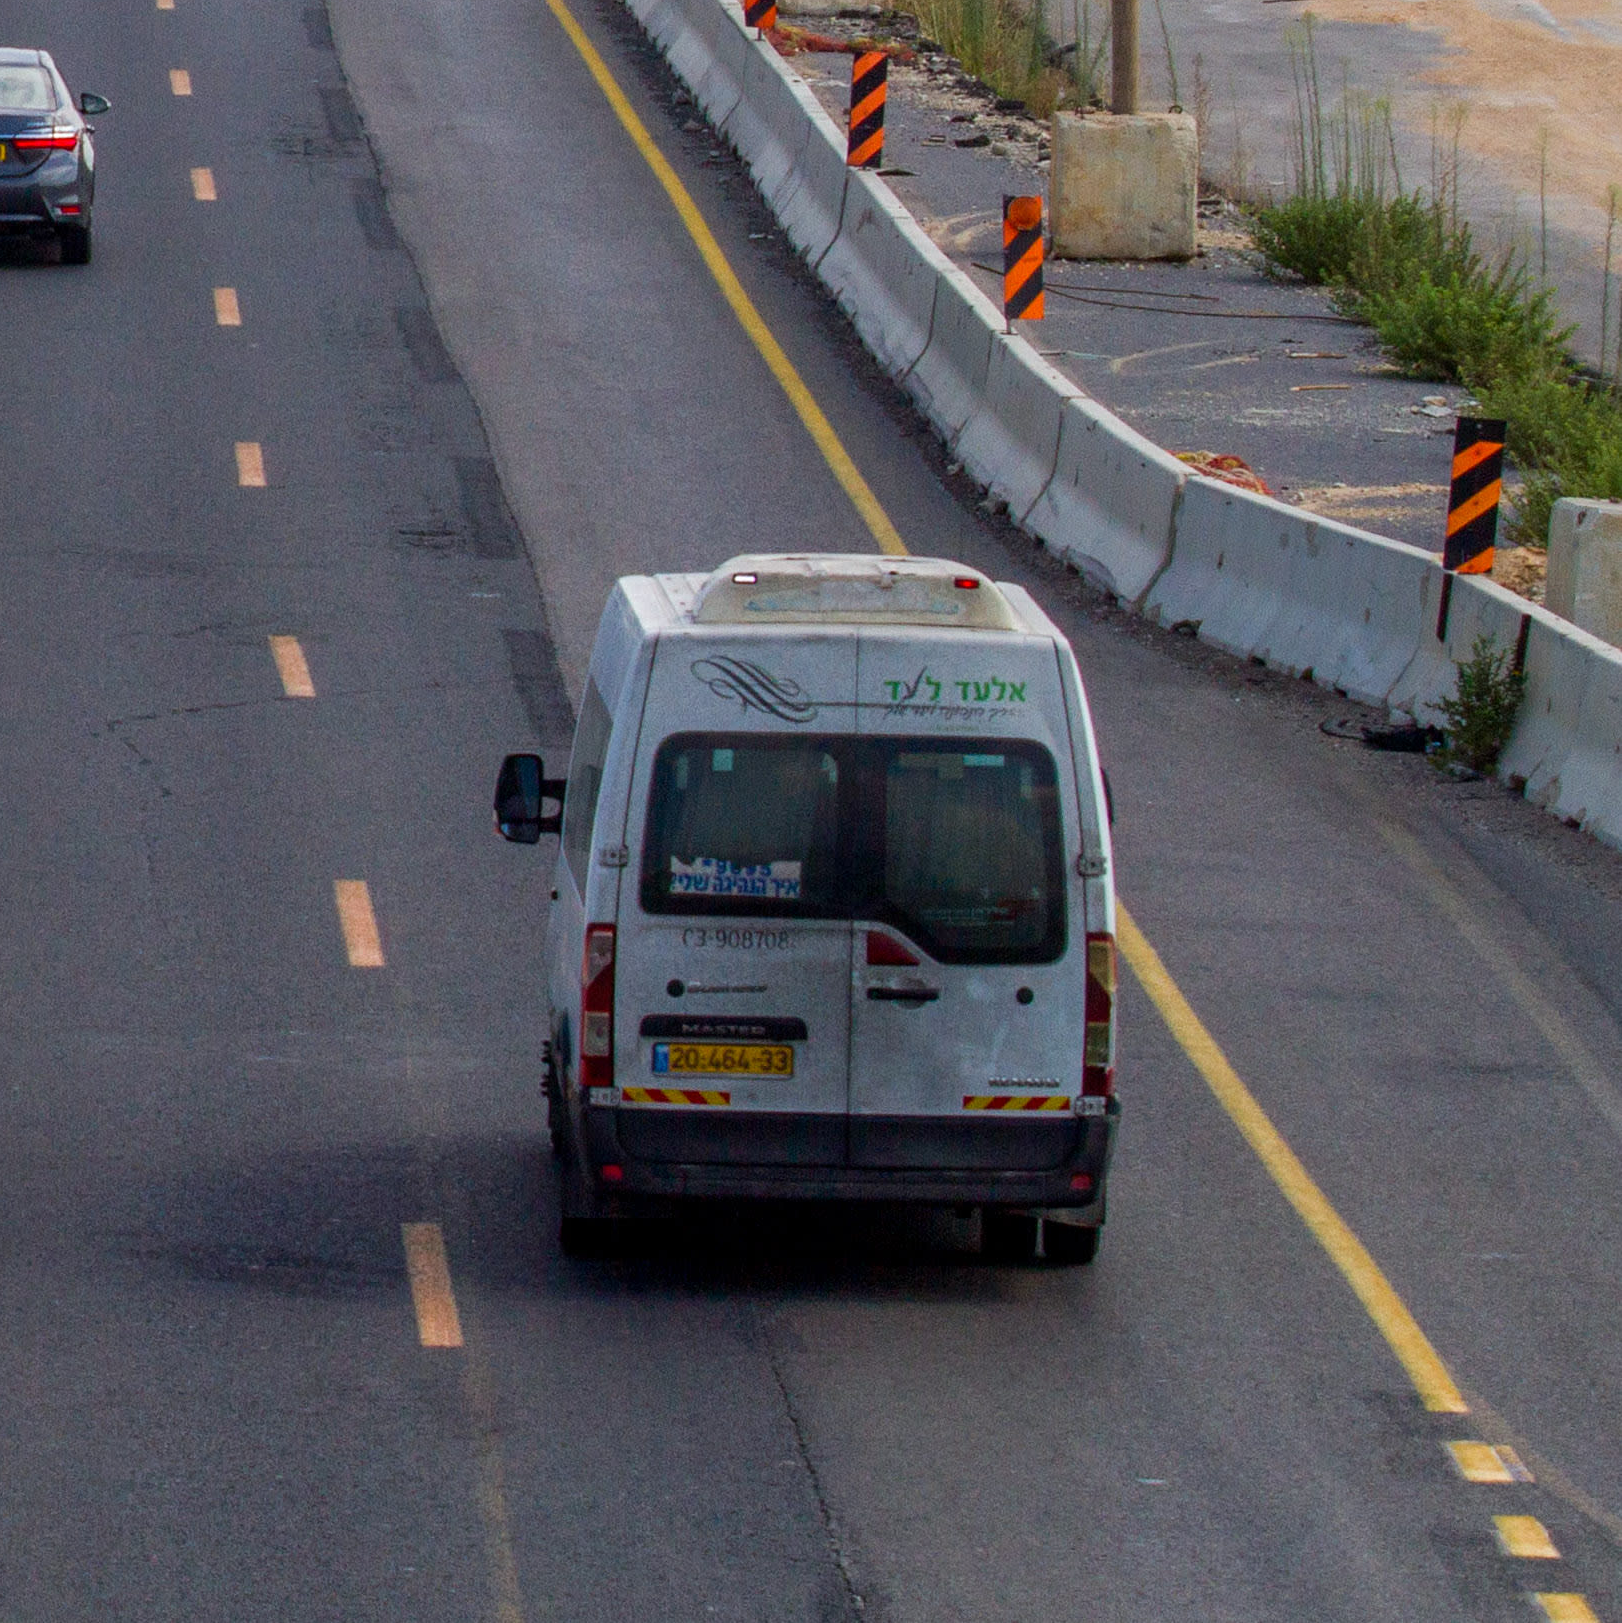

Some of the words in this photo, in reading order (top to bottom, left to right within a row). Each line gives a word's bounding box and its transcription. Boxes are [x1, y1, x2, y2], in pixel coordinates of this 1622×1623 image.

[955, 675, 1027, 703] אלעד
[713, 876, 768, 896] הנהיגה
[770, 878, 801, 898] איך
